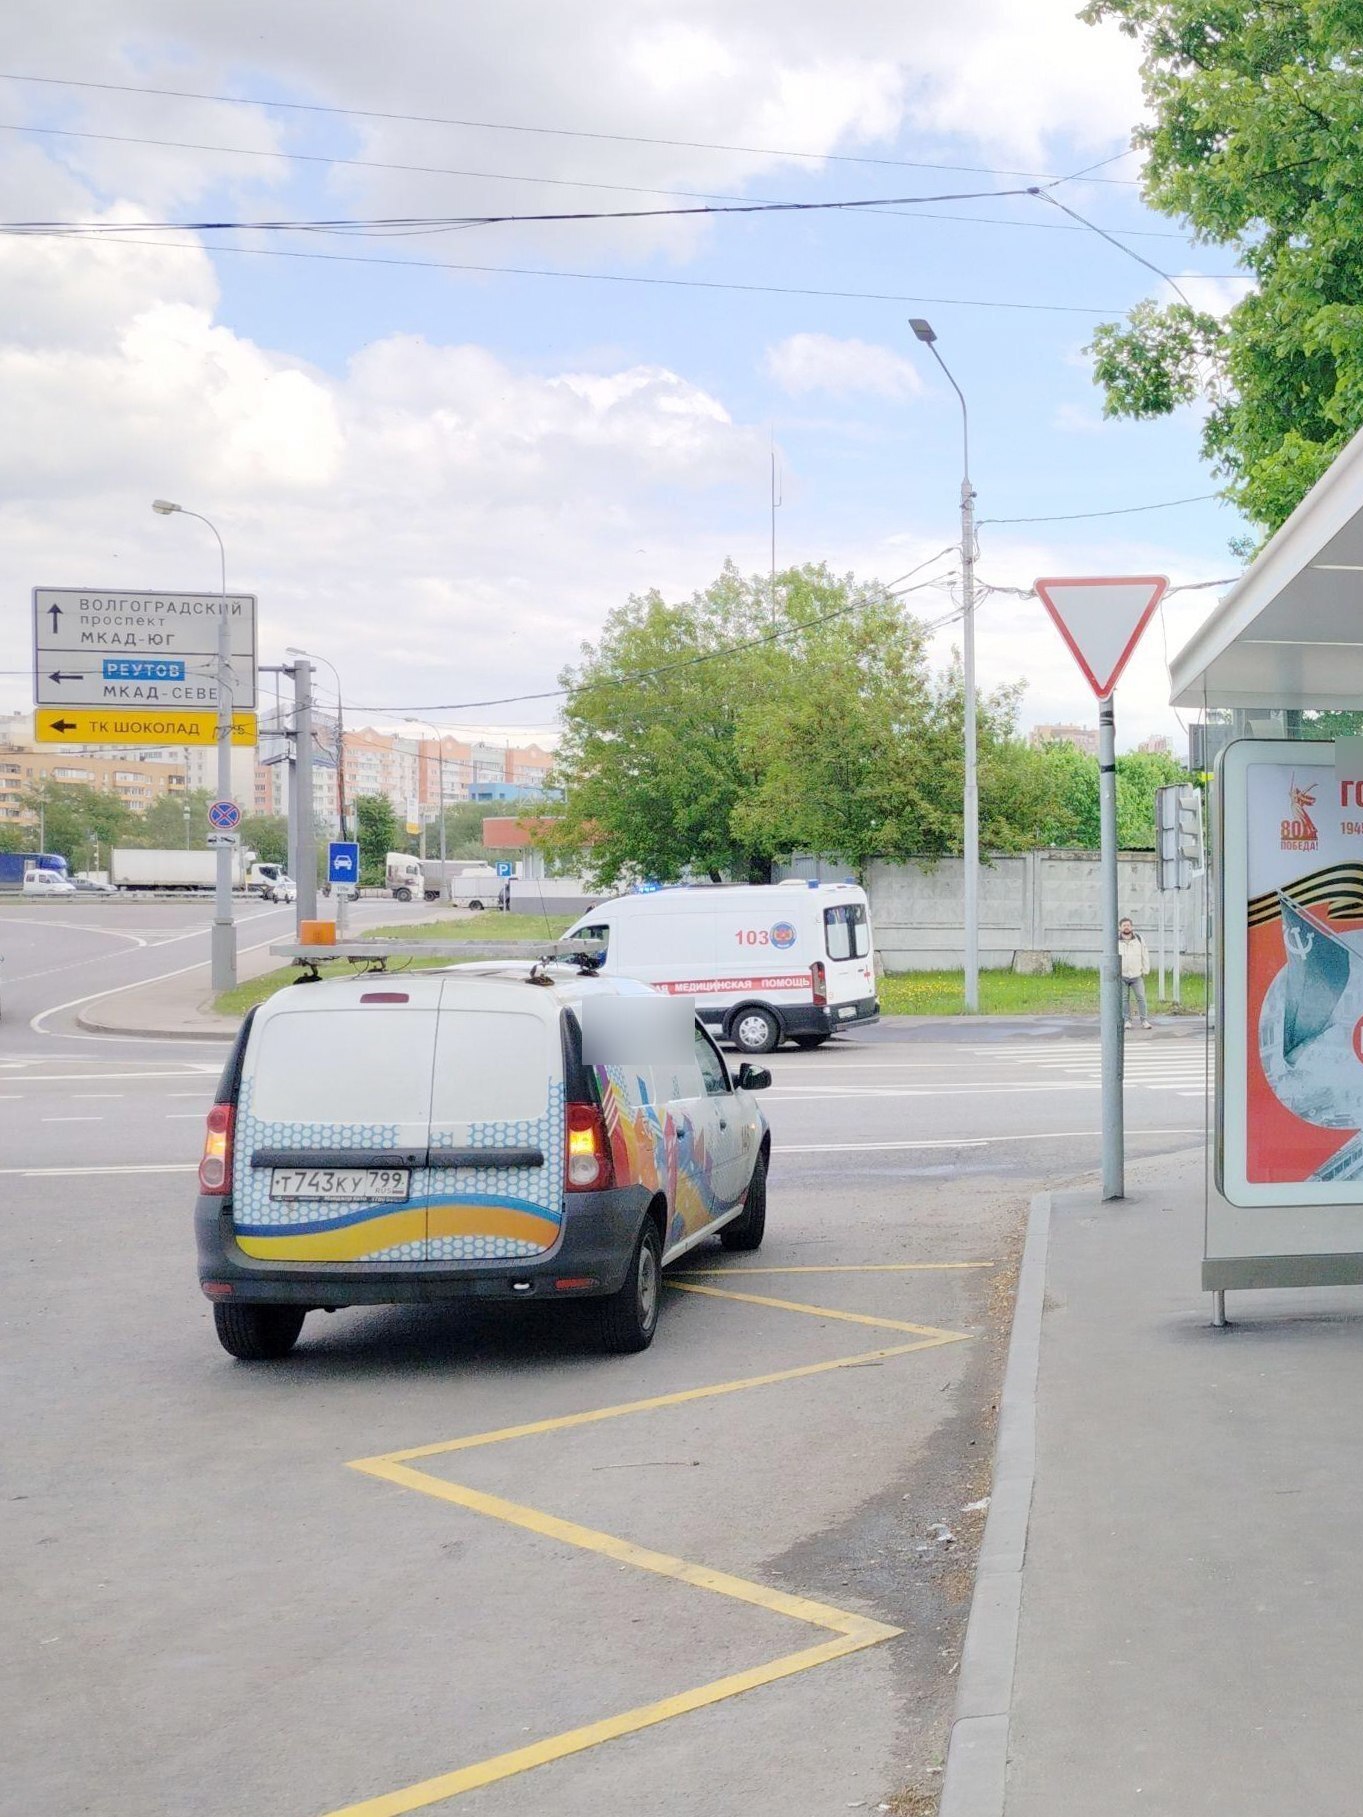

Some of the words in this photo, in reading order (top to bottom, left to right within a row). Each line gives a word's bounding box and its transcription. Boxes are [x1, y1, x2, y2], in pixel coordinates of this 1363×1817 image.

[79, 598, 242, 616] ВОЛГОГРАДСКИЙ
[80, 614, 166, 629] проспект
[80, 632, 175, 646] МКАД-ЮГ
[106, 663, 181, 678] РЕУТОВ
[103, 685, 219, 701] МКАД-СЕВЕ
[89, 721, 108, 733] ТК
[113, 721, 200, 736] ШОКОЛАД
[1280, 840, 1319, 852] ПОБЕДА!
[735, 930, 769, 945] 103
[674, 979, 752, 993] МЕДИЦИНСКАЯ
[761, 976, 810, 990] ПОМОЩЬ
